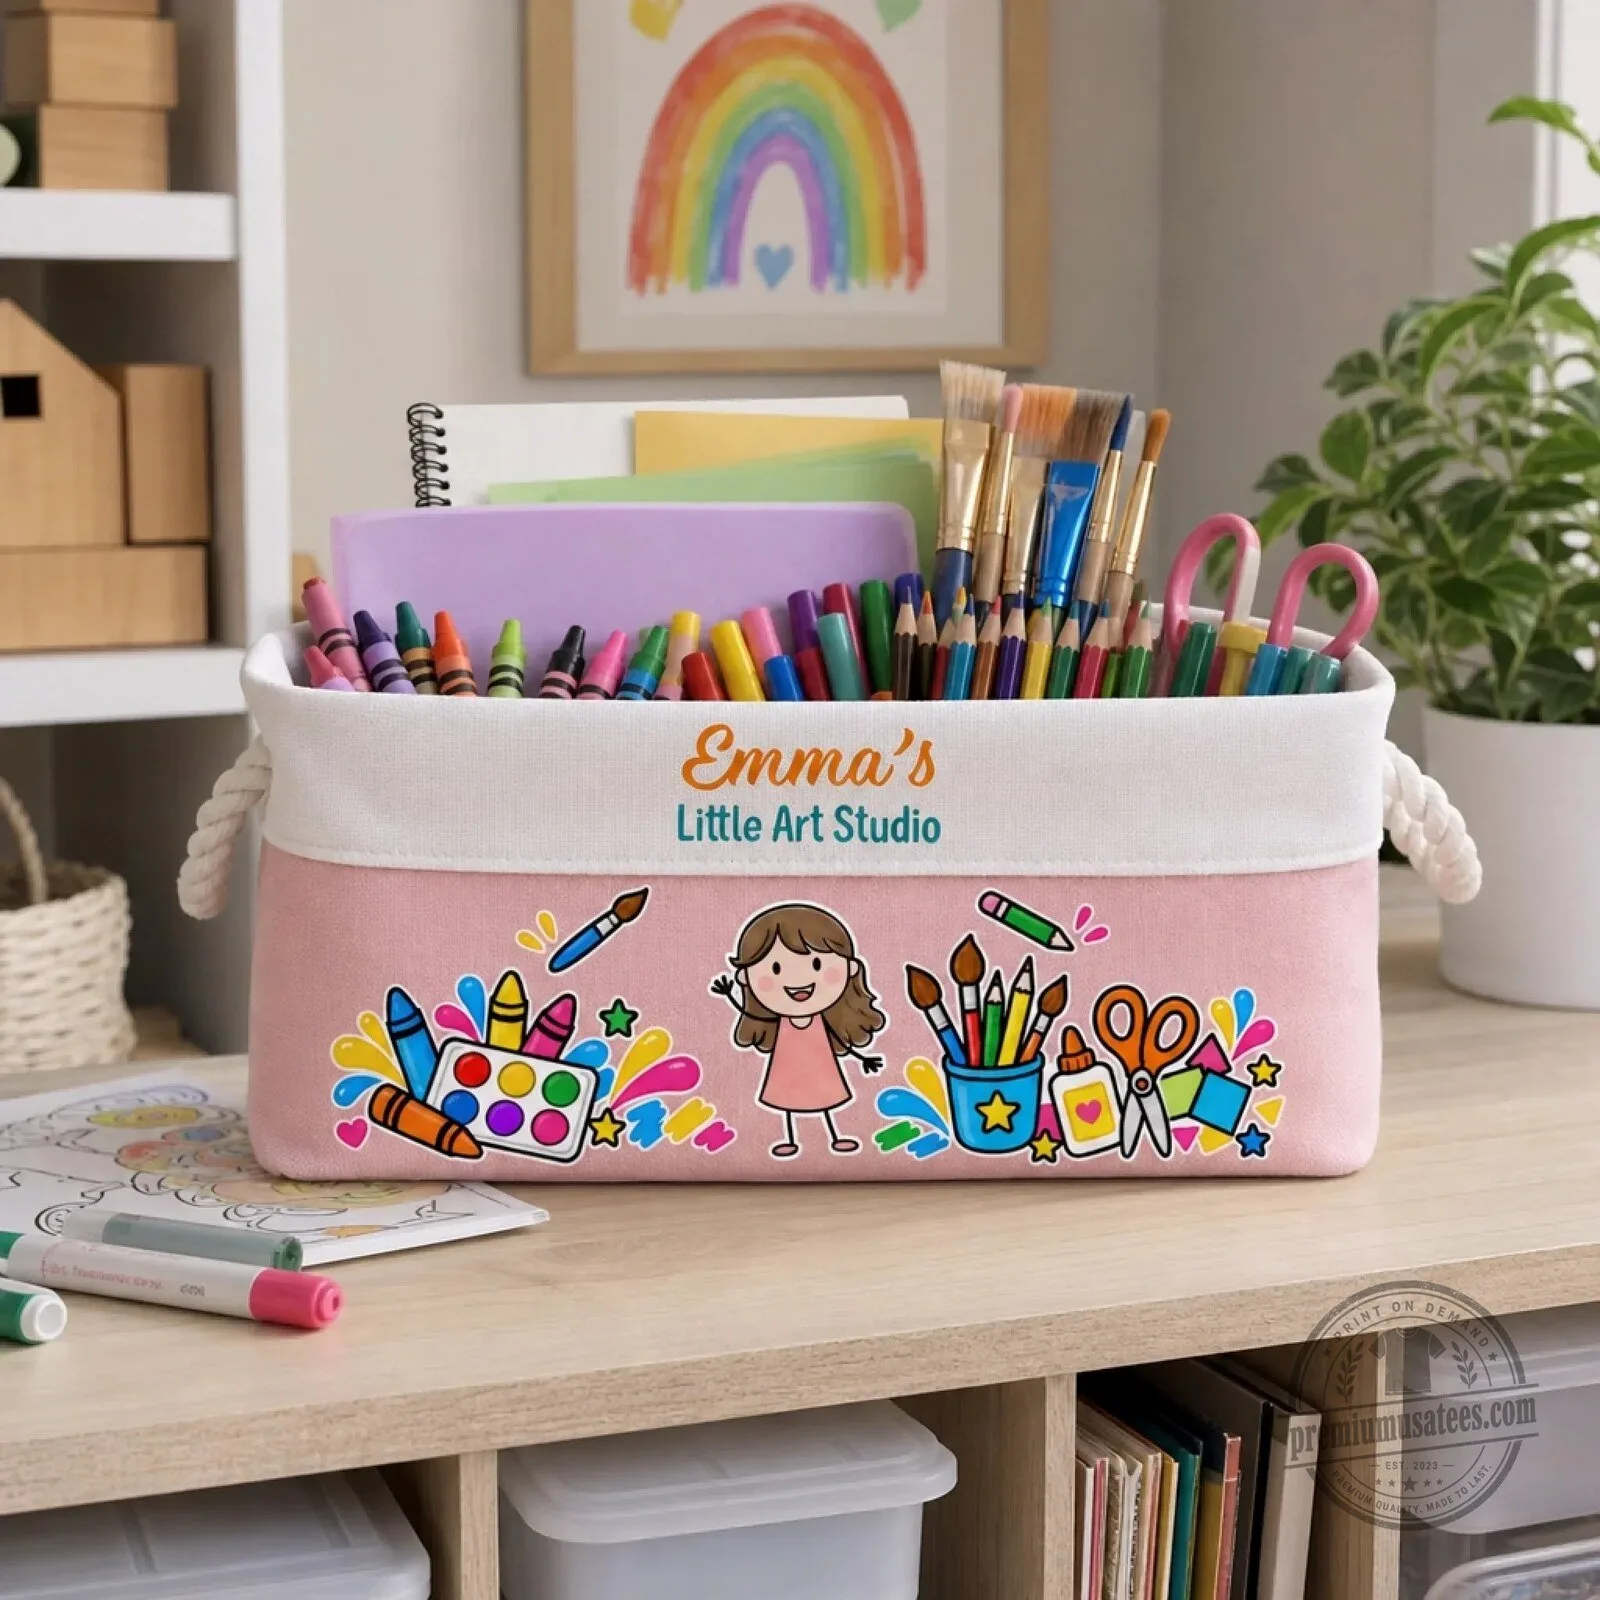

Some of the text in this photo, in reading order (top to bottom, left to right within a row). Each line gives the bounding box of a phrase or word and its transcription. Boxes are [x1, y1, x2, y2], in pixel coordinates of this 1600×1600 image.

[681, 722, 935, 790] Emma’s
[677, 803, 942, 844] Little Art Studio
